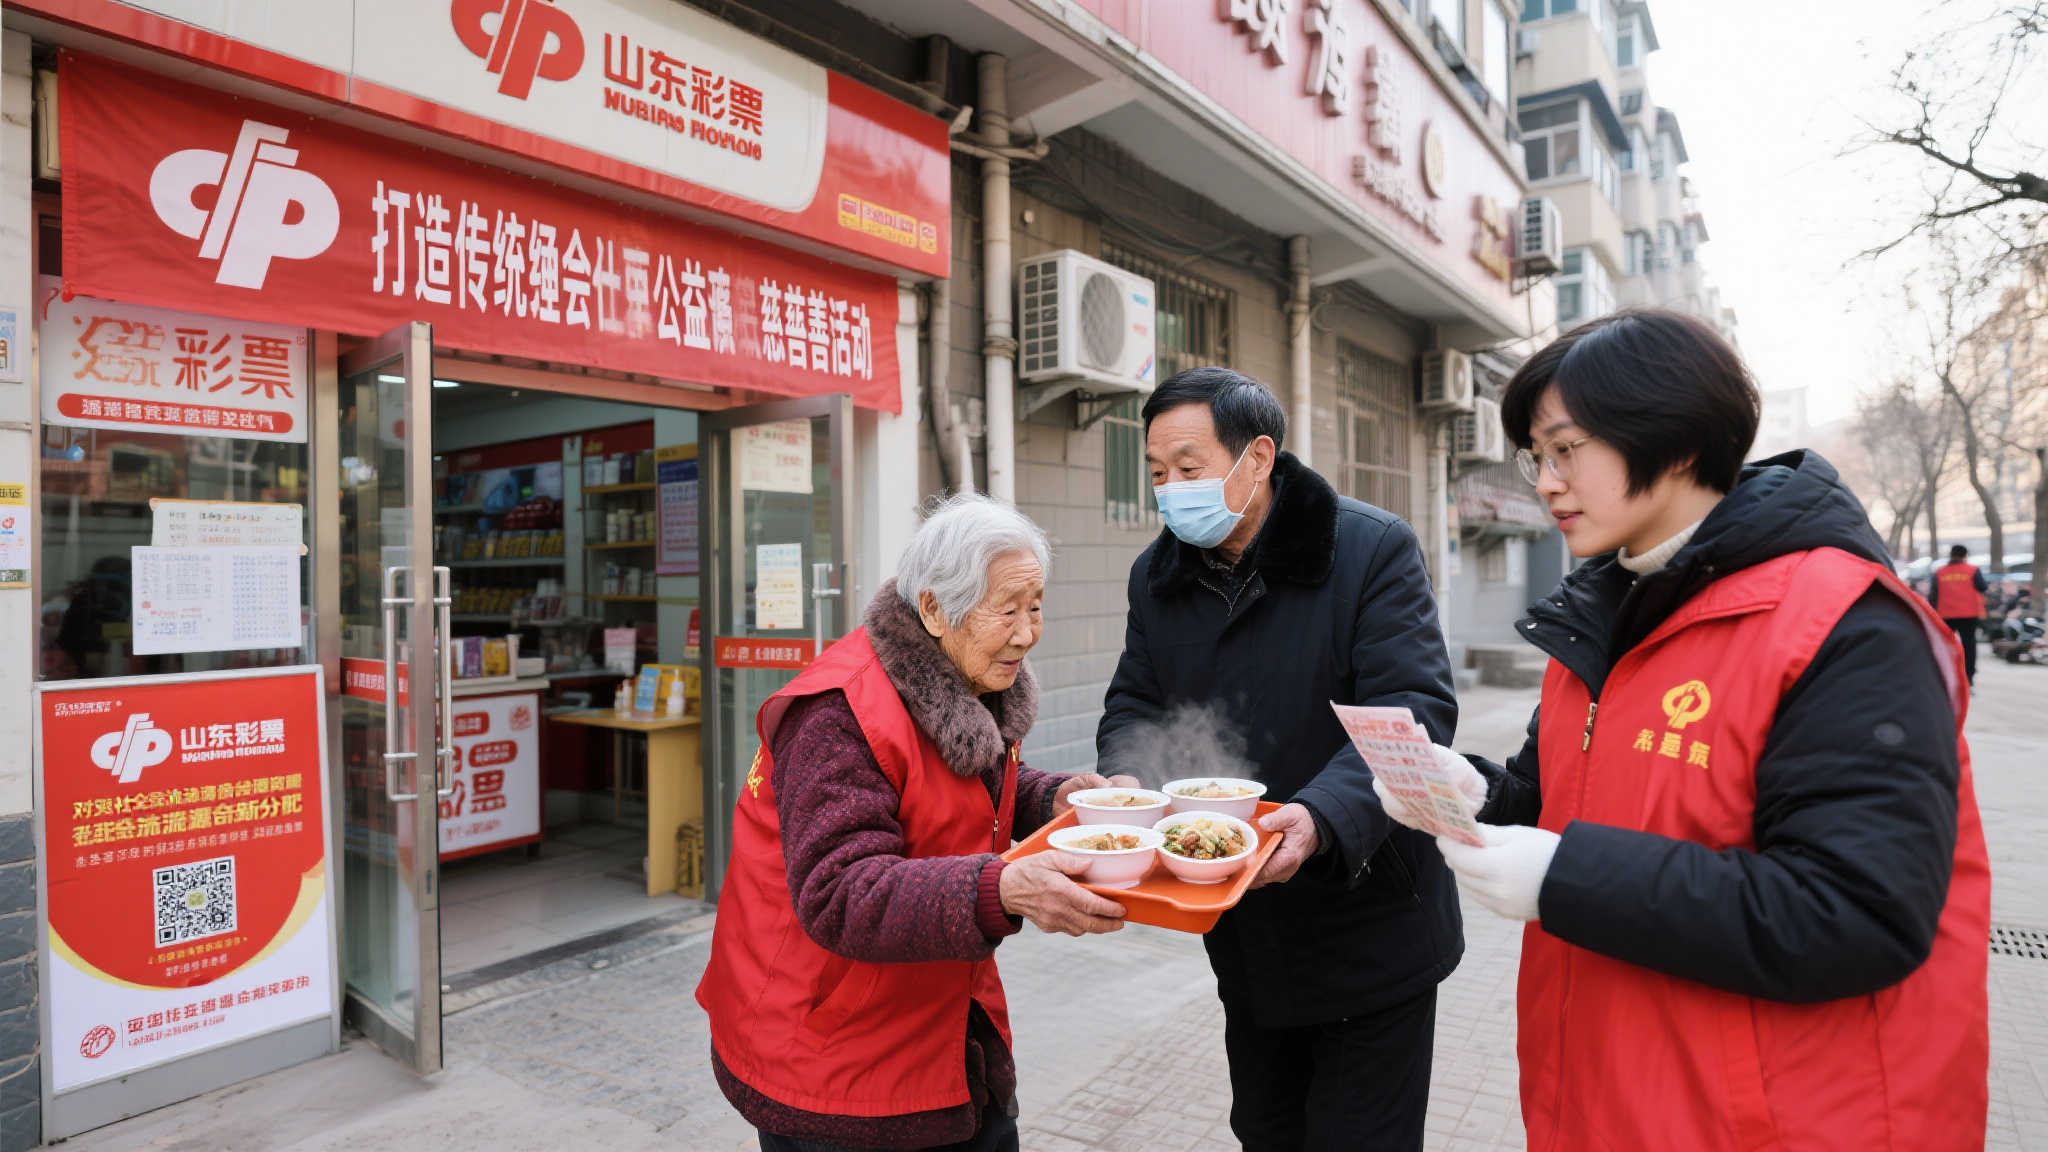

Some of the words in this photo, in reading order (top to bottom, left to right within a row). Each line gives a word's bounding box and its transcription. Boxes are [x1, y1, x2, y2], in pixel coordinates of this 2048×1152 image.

[604, 33, 763, 136] 山东彩票
[180, 719, 286, 751] 山东彩票
